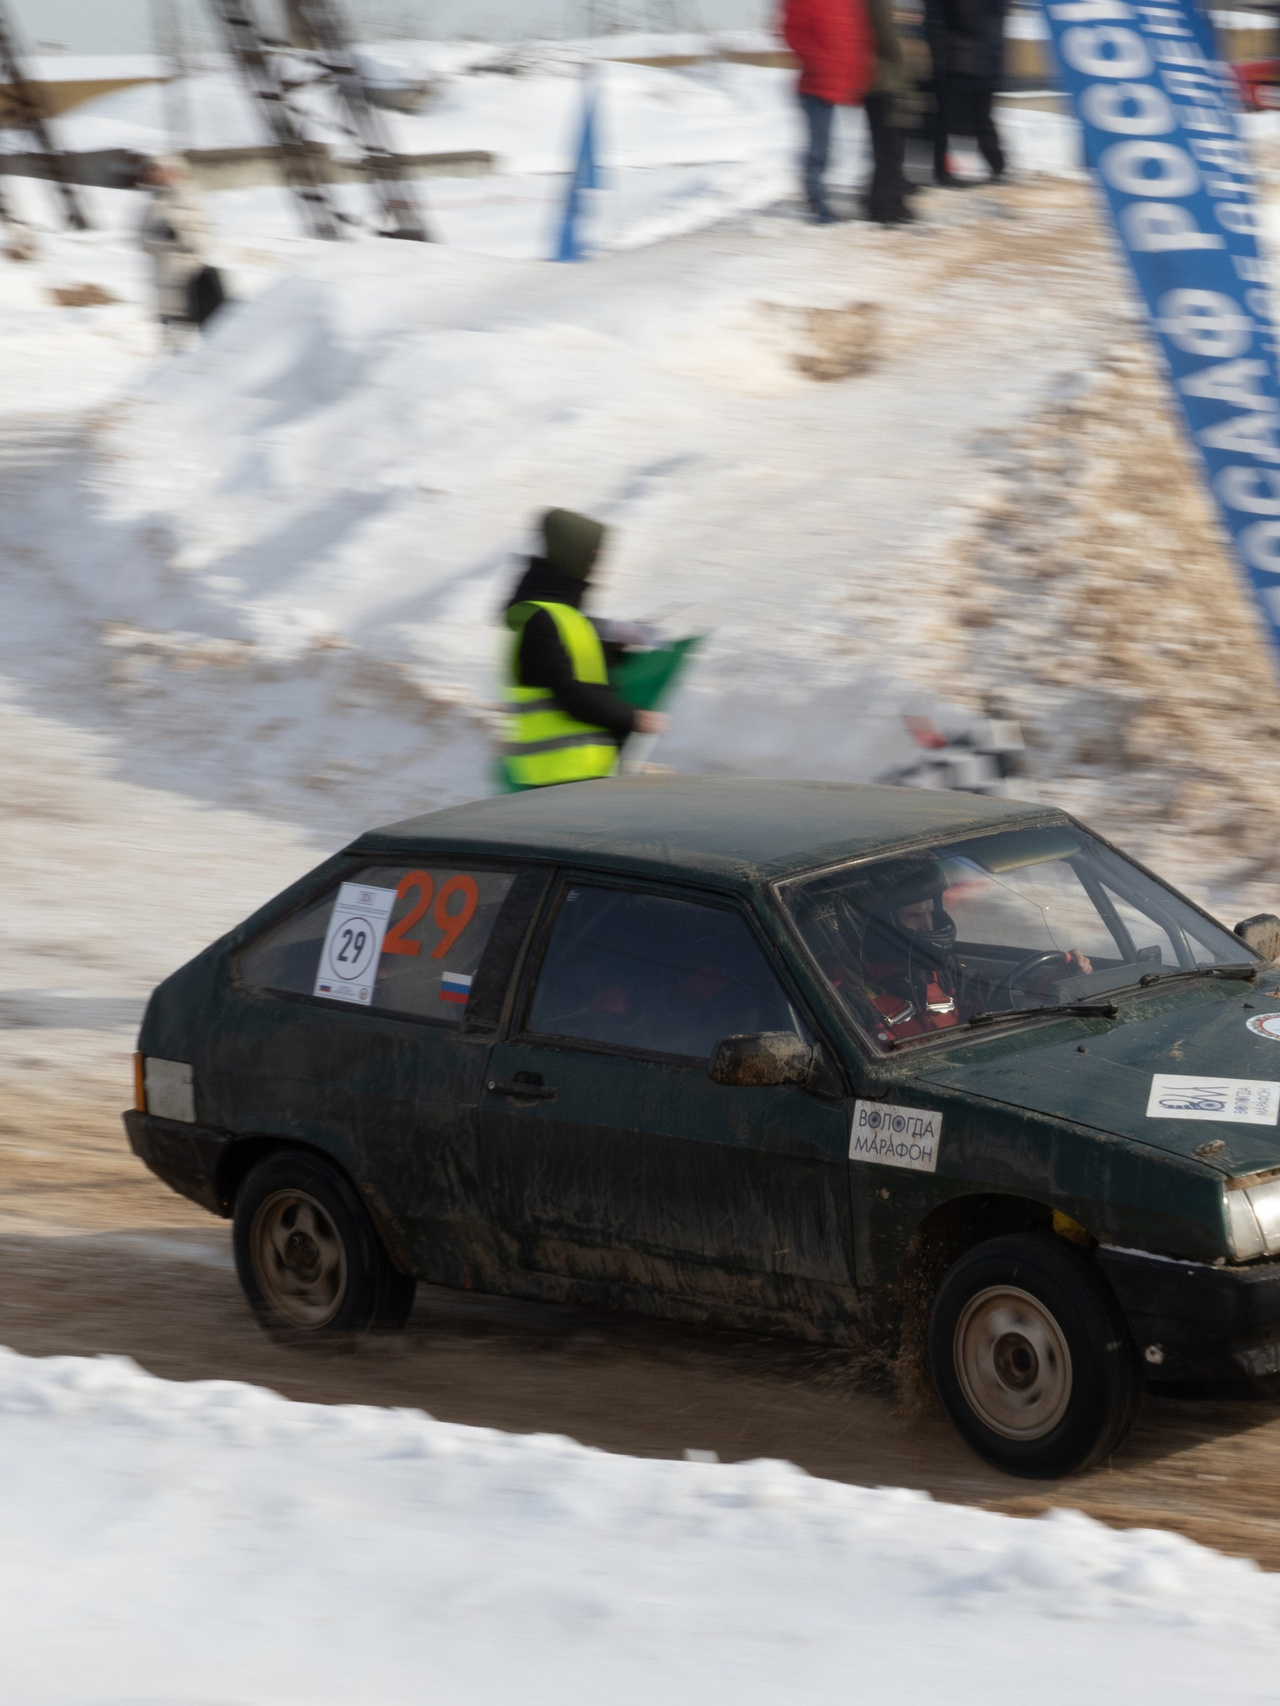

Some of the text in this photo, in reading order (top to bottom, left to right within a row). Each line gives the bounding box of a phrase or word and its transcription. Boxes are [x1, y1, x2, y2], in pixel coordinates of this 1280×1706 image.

[382, 870, 478, 958] 29
[337, 929, 366, 963] 29
[859, 1109, 934, 1138] ВОЛОГДА
[855, 1132, 933, 1162] МАРАФОН
